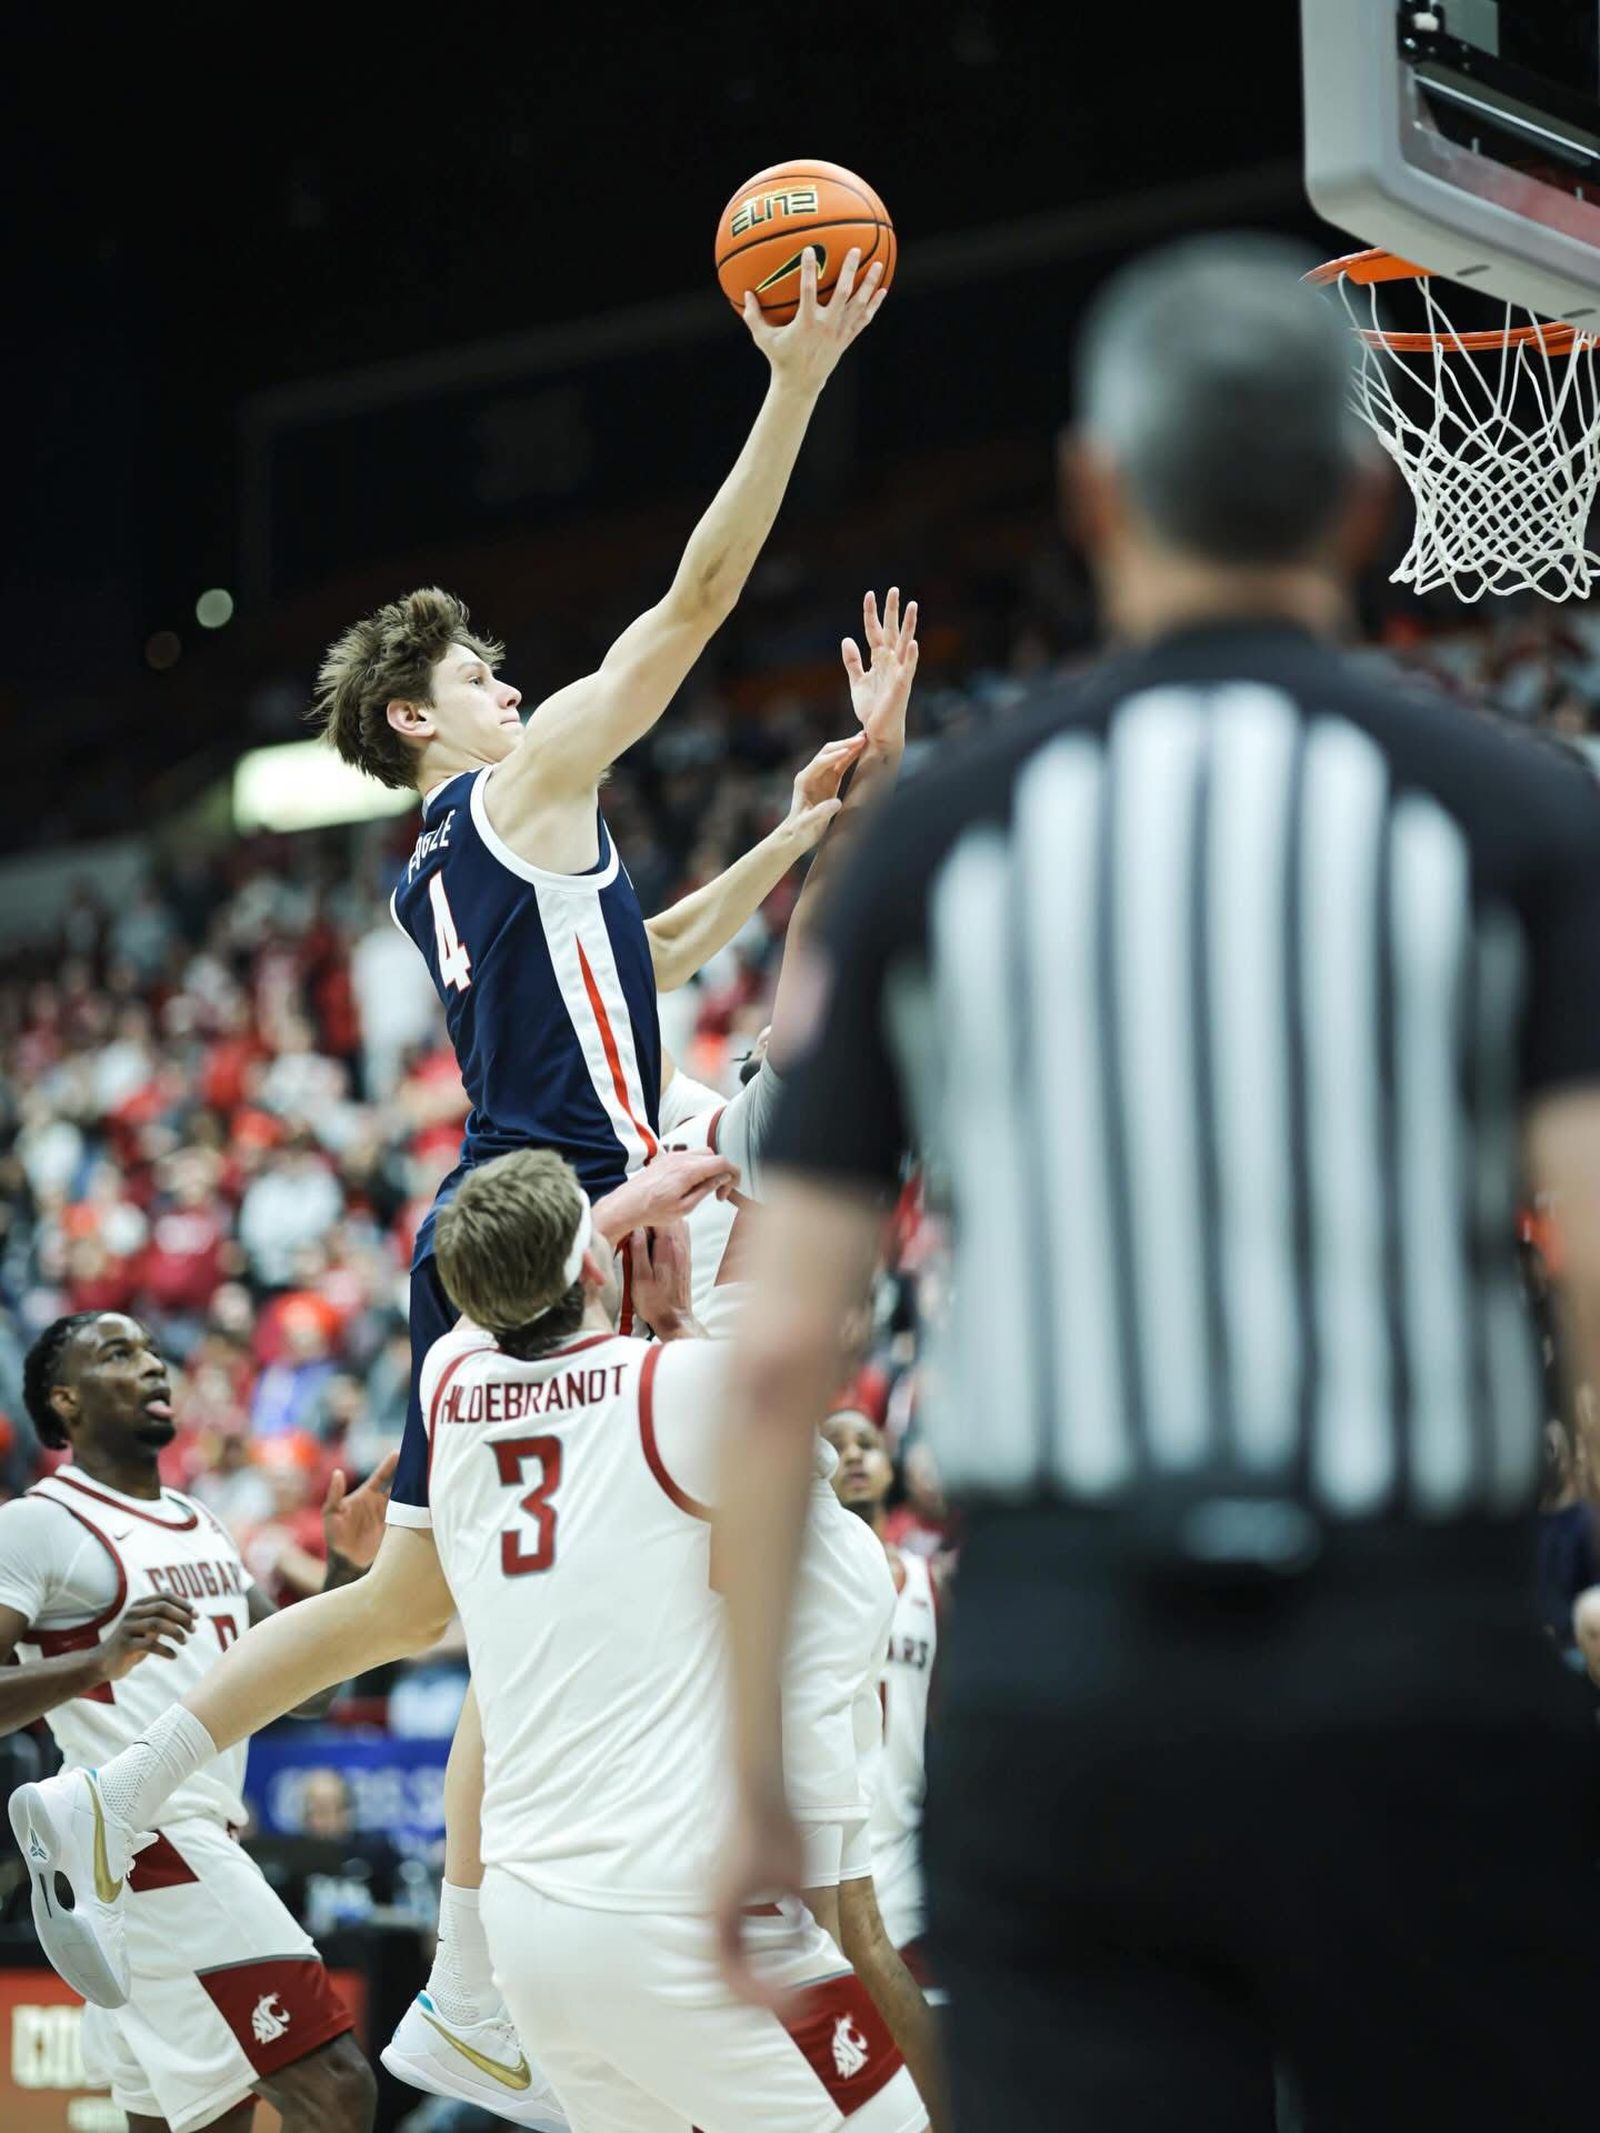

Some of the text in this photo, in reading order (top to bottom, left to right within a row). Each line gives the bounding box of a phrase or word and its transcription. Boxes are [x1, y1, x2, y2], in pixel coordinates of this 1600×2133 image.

[731, 190, 817, 237] ELITE
[428, 869, 472, 993] 4
[484, 1434, 564, 1578] 3
